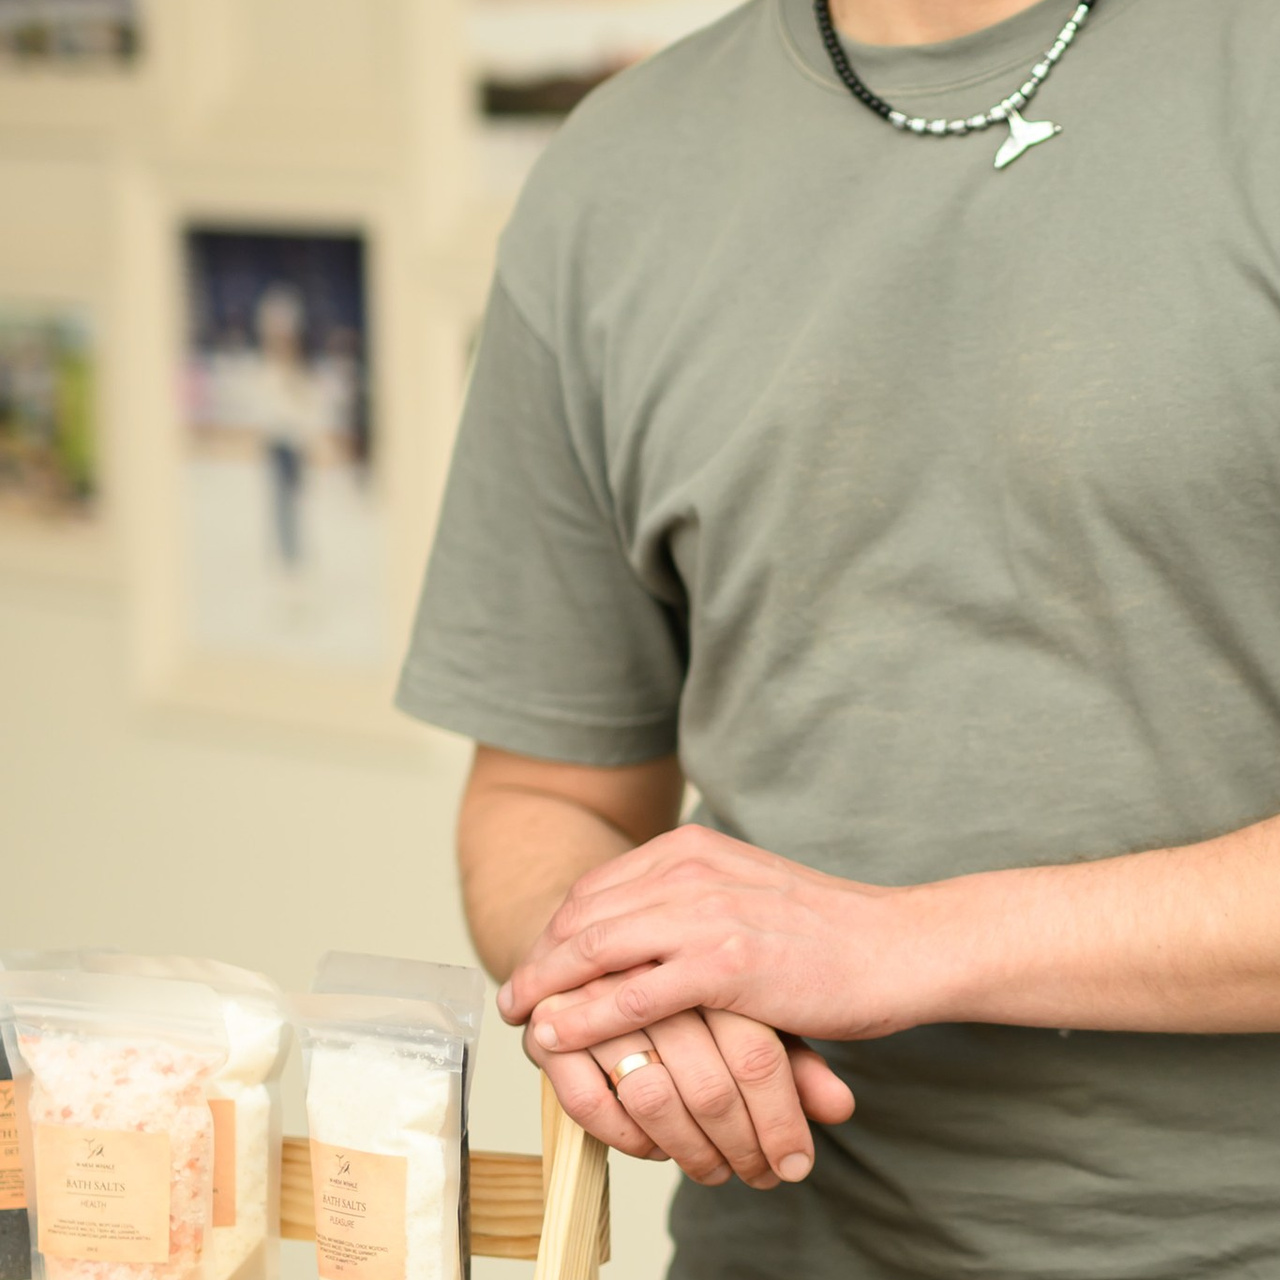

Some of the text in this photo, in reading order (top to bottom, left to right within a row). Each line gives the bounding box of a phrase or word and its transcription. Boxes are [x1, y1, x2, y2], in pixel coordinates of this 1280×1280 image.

[66, 1178, 126, 1192] BATH SALTS
[80, 1200, 107, 1209] HEALTH
[322, 1194, 367, 1212] BATH SALTS
[329, 1215, 356, 1228] PLEASURE
